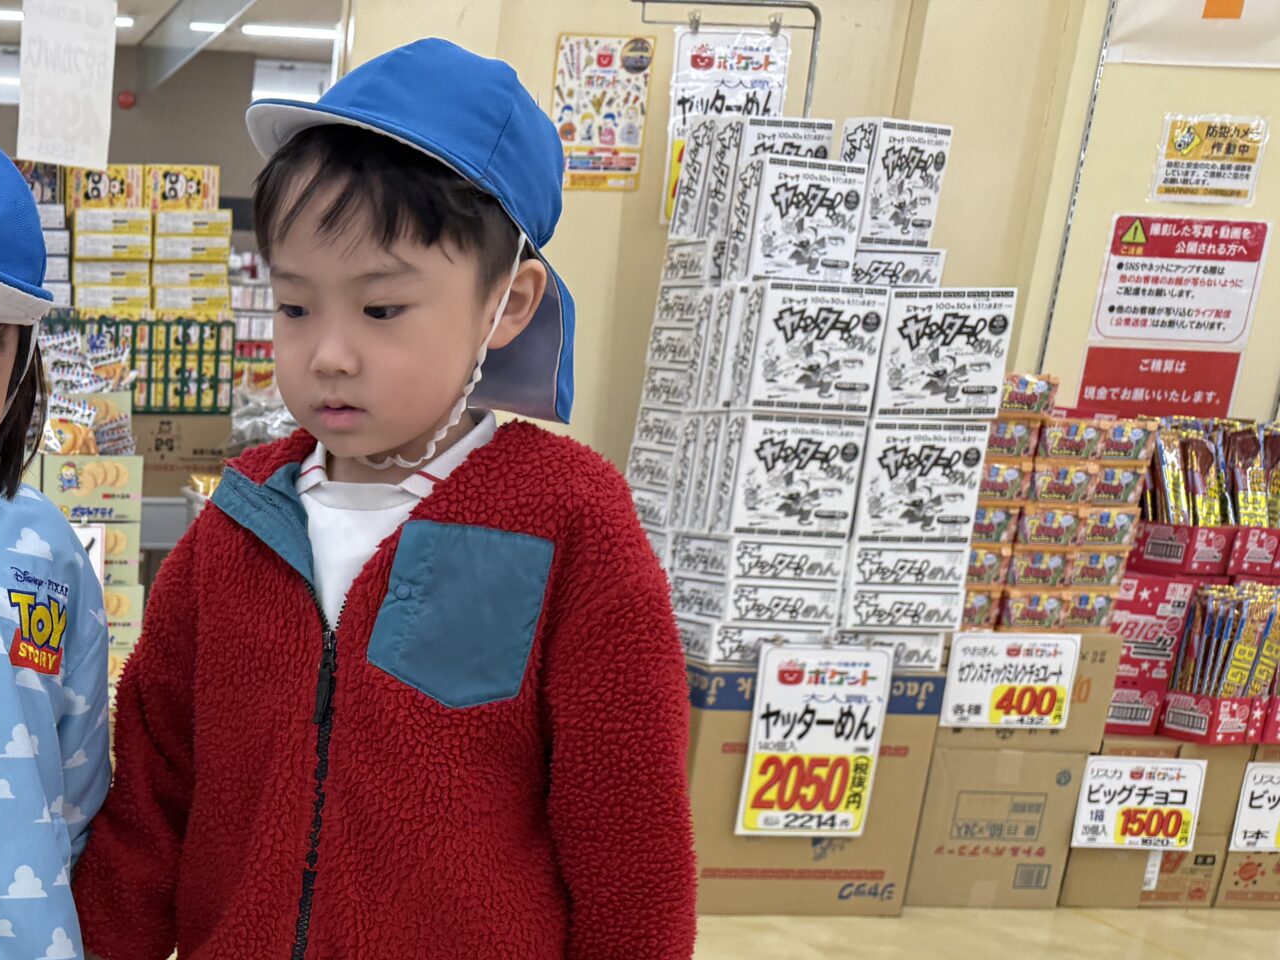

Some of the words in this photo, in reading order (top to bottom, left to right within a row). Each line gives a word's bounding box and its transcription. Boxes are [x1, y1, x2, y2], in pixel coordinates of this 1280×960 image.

[717, 52, 777, 71] ポケット
[1211, 141, 1250, 156] 作動中
[1149, 222, 1252, 240] 撮影した写真・動画を
[1175, 241, 1247, 256] 公開される方へ
[1139, 358, 1186, 373] ご精算は
[1084, 386, 1221, 404] 現金でお願いいたします。
[7, 589, 67, 653] TOY
[18, 641, 59, 670] STORY
[808, 669, 877, 686] ポケット
[953, 704, 982, 716] 各種
[996, 687, 1057, 716] 400
[760, 703, 876, 741] ヤッターめん
[1091, 768, 1122, 779] リスカ
[751, 755, 850, 811] 2050
[1087, 784, 1188, 806] ビッグチョコ
[783, 813, 838, 829] 2214
[1120, 808, 1183, 838] 1500
